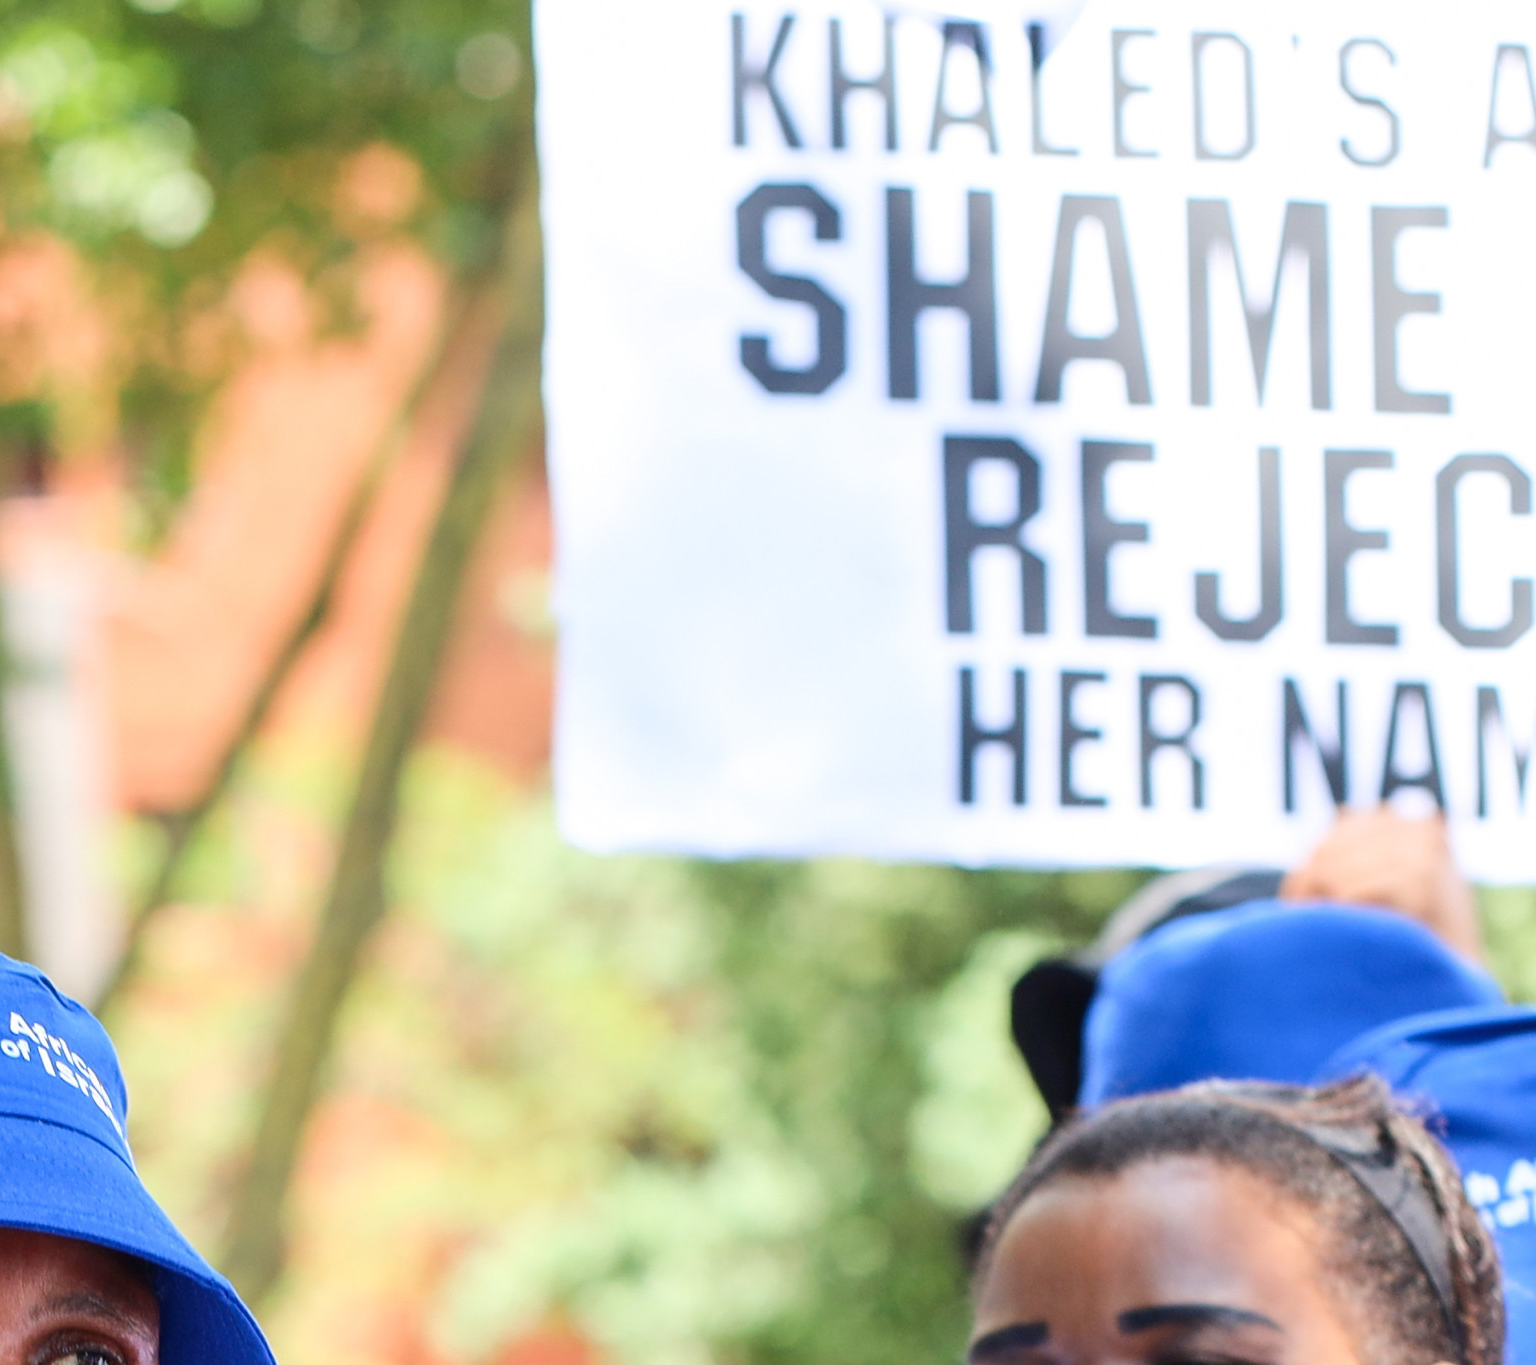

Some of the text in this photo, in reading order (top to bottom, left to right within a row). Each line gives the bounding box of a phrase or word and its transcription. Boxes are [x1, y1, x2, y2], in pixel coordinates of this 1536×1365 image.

[734, 182, 1454, 415] SHAME
[957, 665, 1207, 810] HER
[0, 1039, 31, 1062] of
